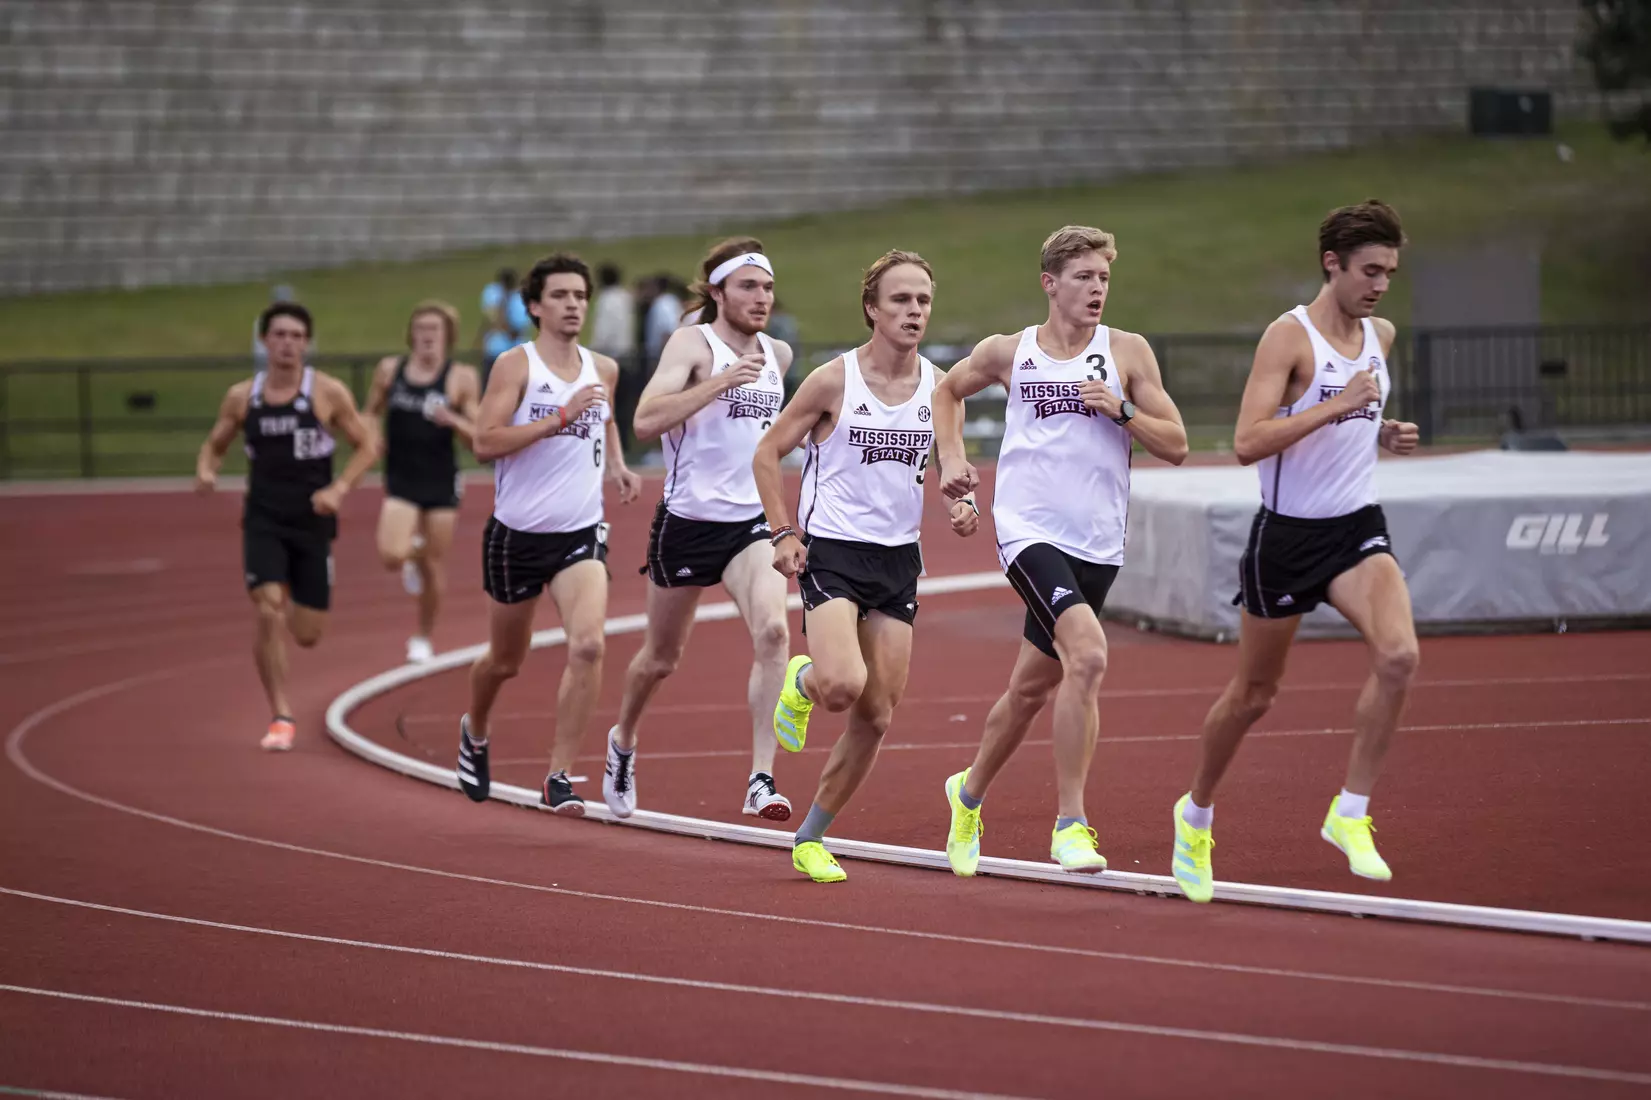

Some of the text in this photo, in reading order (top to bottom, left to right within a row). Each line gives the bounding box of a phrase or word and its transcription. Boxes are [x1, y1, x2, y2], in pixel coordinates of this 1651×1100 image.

[1086, 354, 1107, 382] 3
[1020, 384, 1080, 399] MISSISS
[1045, 401, 1087, 415] STATE
[849, 429, 932, 447] MISSISSIPPI
[593, 438, 602, 468] 6
[871, 449, 910, 462] STATE
[1506, 513, 1609, 550] GILL
